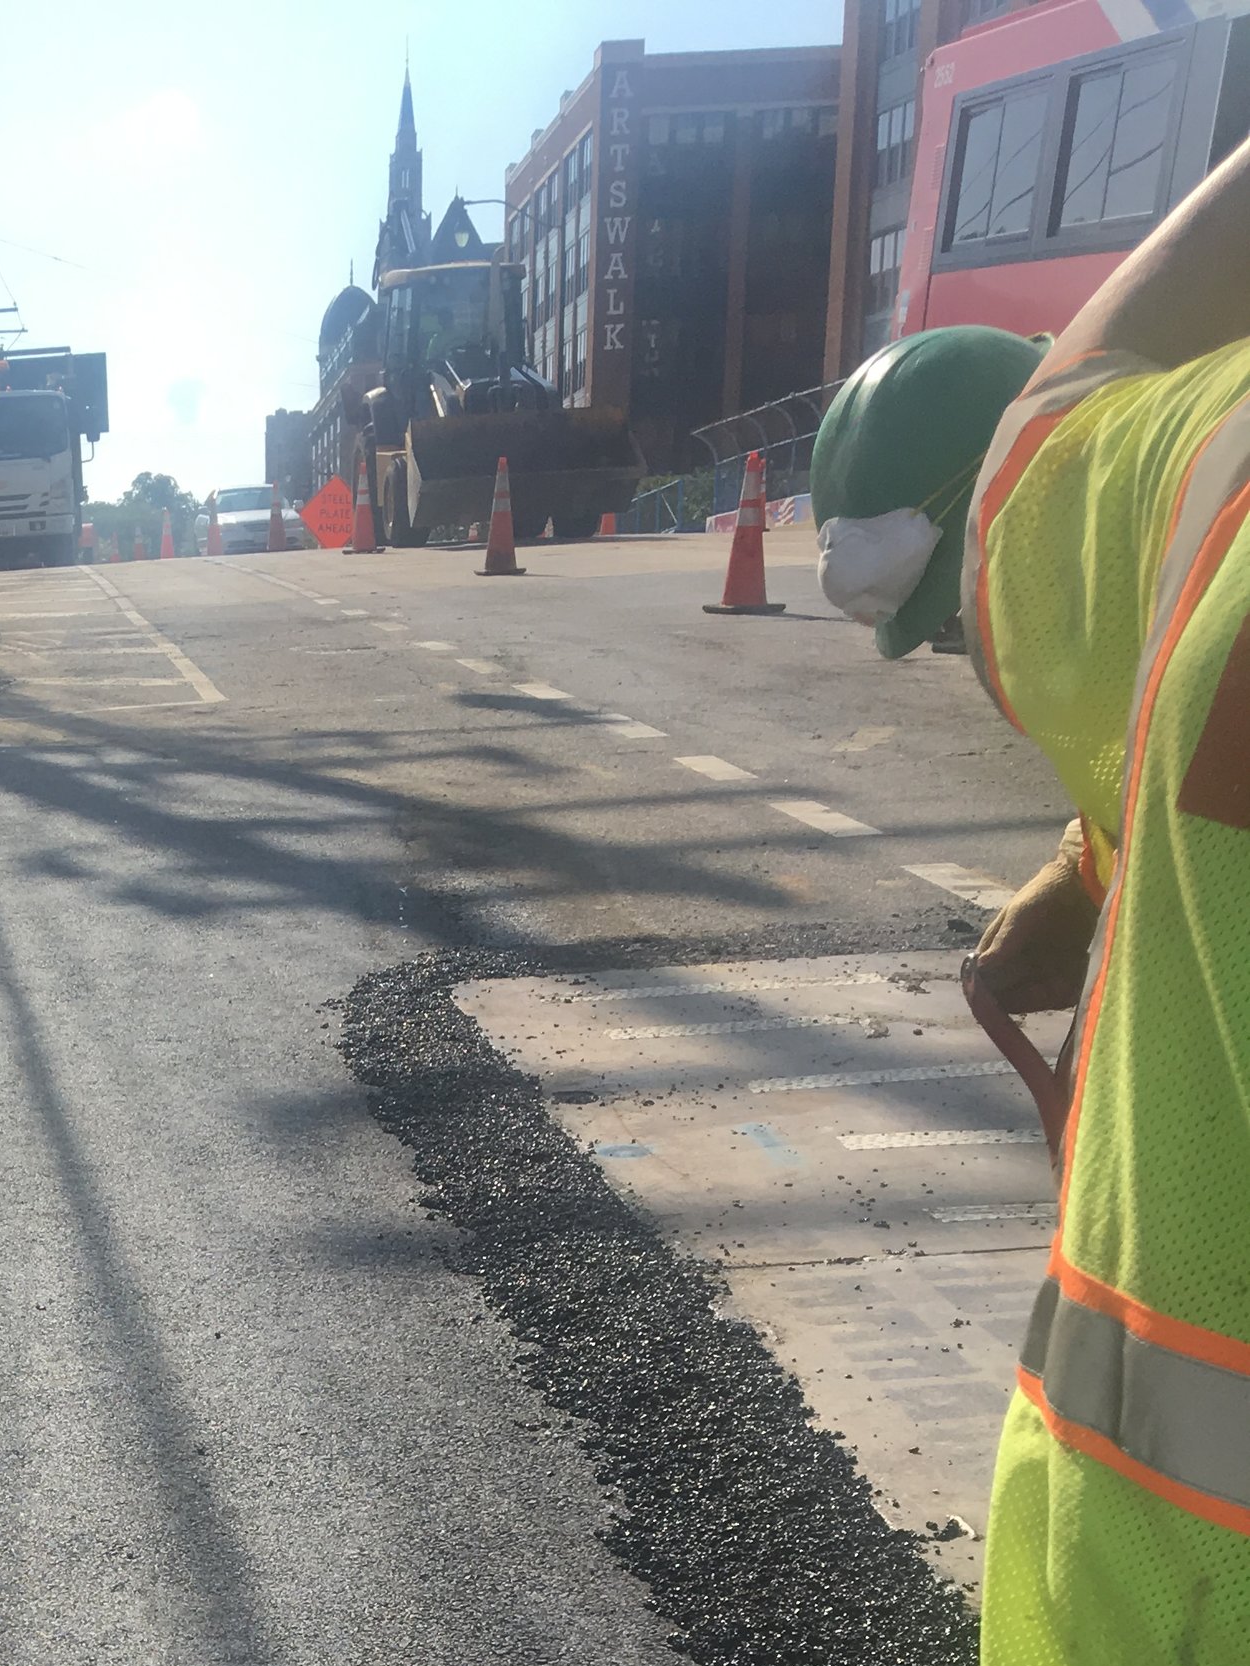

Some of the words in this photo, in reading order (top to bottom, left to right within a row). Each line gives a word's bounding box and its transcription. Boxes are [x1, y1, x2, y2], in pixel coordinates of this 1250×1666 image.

[604, 69, 634, 350] ARTSWALK
[320, 493, 351, 505] STEEL
[319, 508, 351, 520] PLATE
[317, 523, 352, 534] AHEAD
